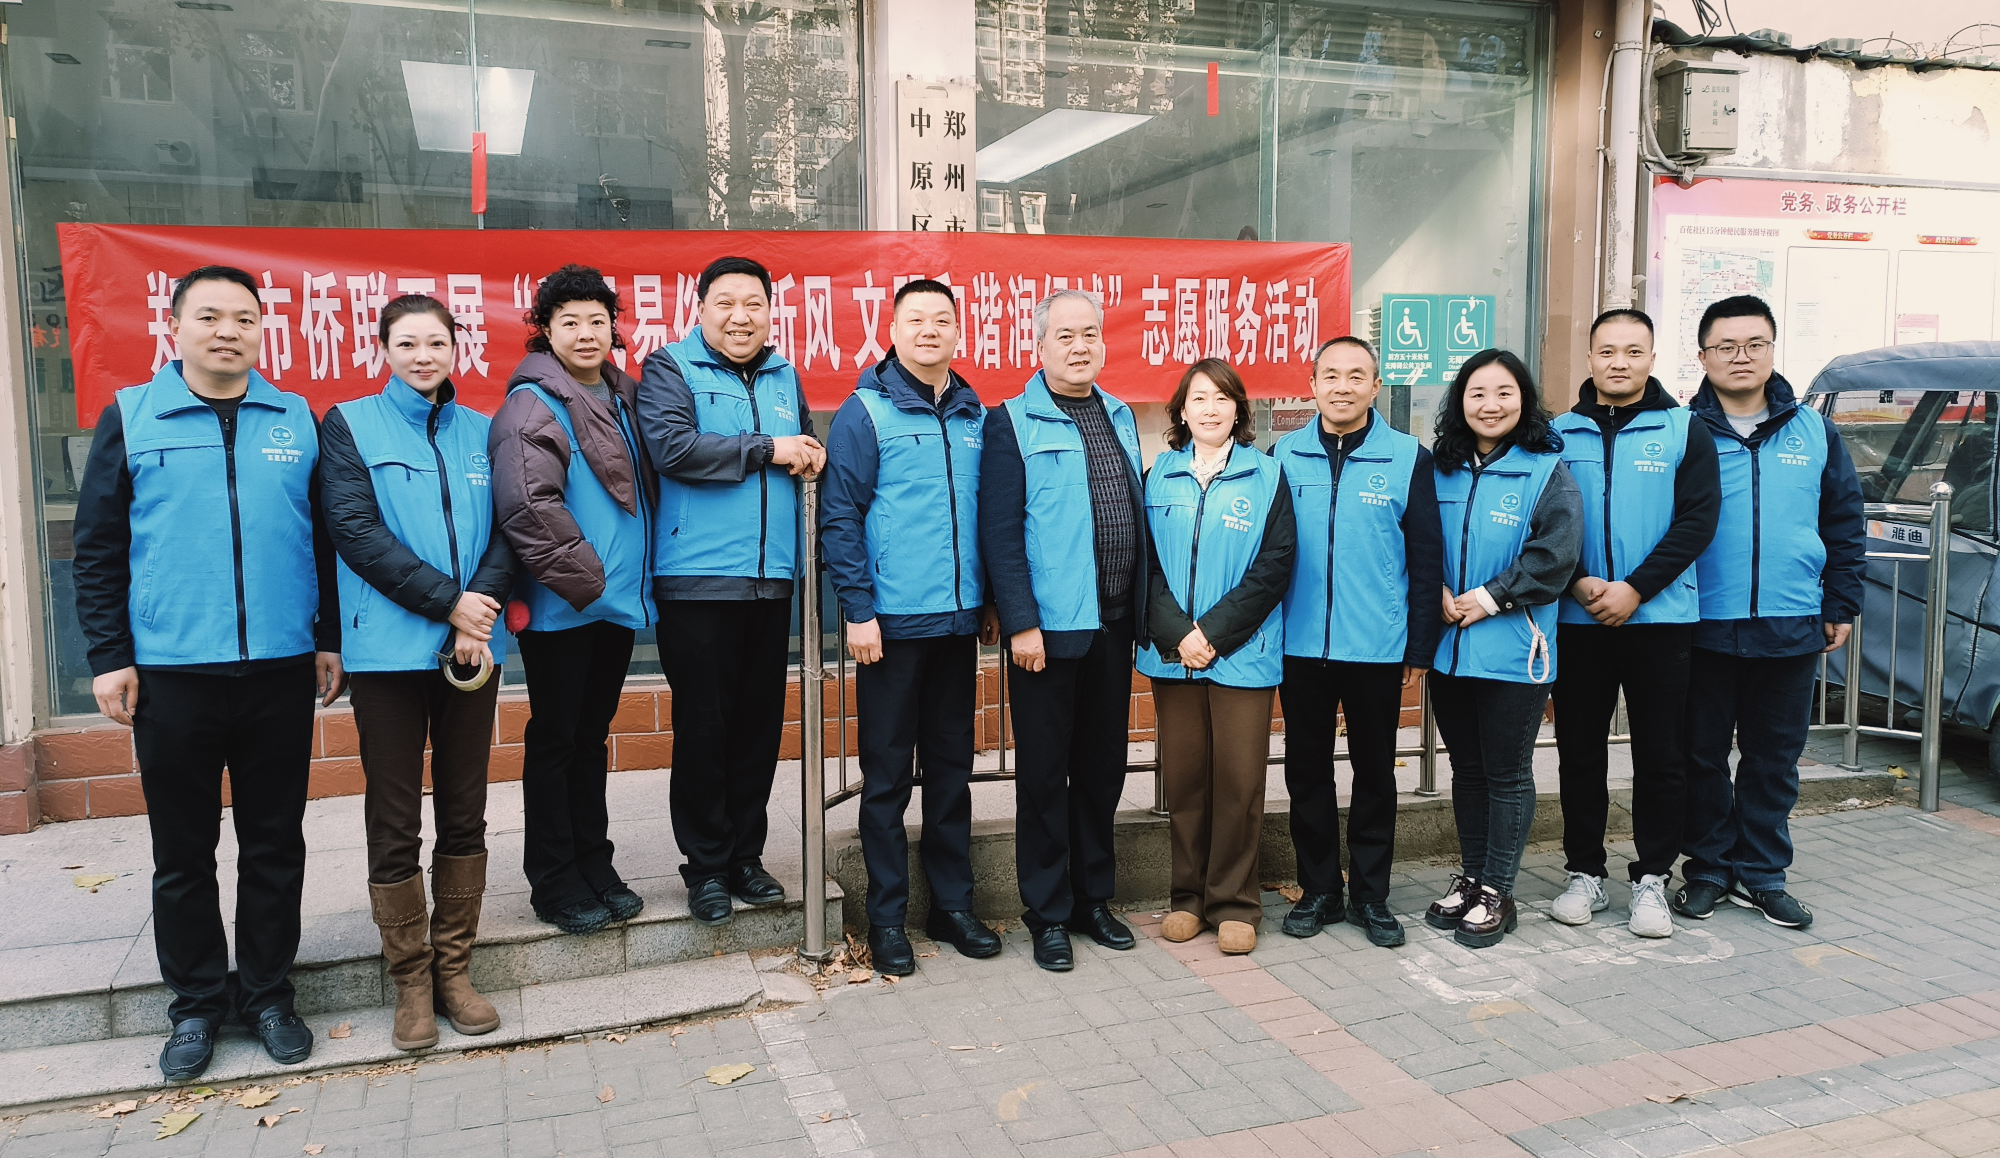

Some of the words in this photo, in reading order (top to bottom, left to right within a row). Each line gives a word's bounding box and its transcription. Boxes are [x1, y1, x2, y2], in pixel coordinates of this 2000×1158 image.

[943, 110, 967, 232] 郑州市
[1780, 191, 1907, 216] 党务、政务公开栏
[146, 270, 490, 381] 郑市侨联展
[1141, 274, 1320, 367] 志愿服务活动
[1891, 526, 1923, 544] 雅迪
